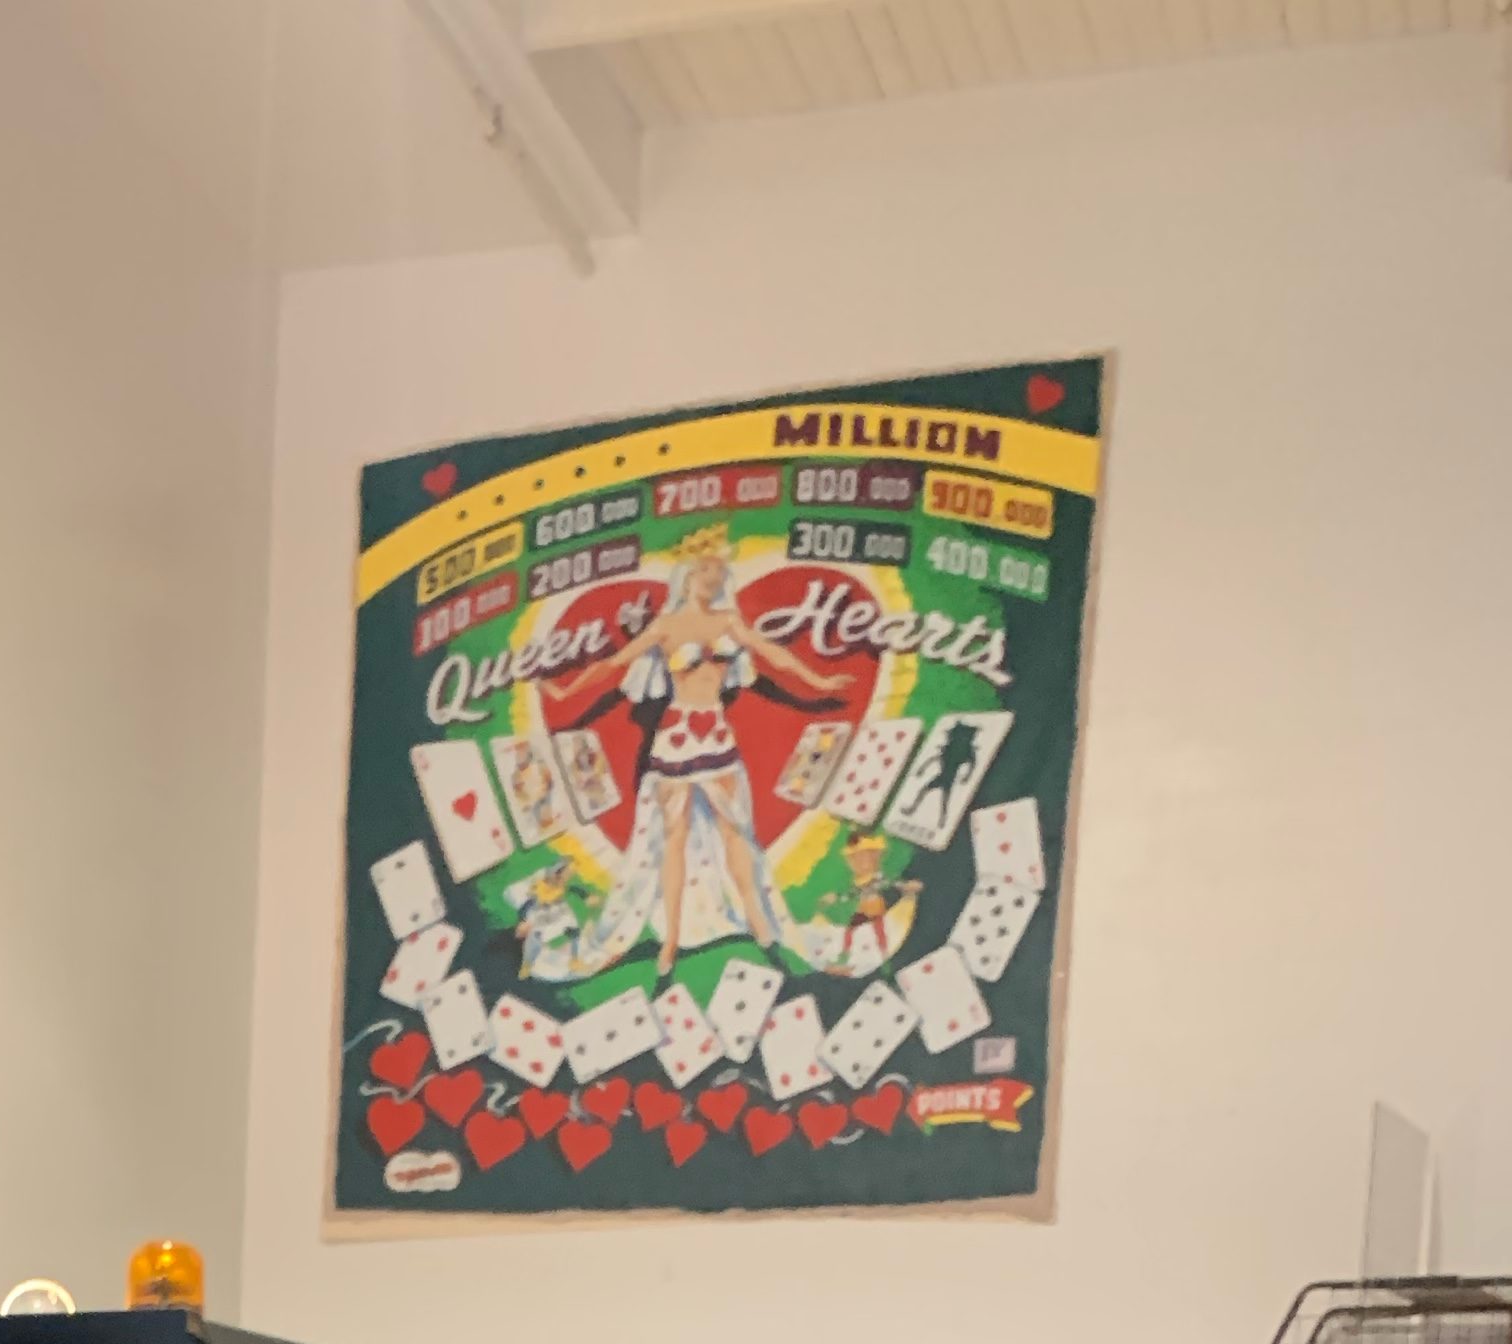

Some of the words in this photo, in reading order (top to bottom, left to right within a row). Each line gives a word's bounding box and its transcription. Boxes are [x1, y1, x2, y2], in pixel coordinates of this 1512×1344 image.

[774, 413, 1001, 460] MILLION
[657, 476, 722, 515] 700
[796, 468, 858, 502] 800
[931, 479, 994, 518] 900
[536, 503, 595, 546] 600
[792, 521, 856, 558] 300
[531, 550, 592, 597] 200
[926, 536, 988, 580] 400
[422, 597, 471, 649] 100
[426, 617, 612, 725] Queen
[753, 579, 1014, 686] Hearts
